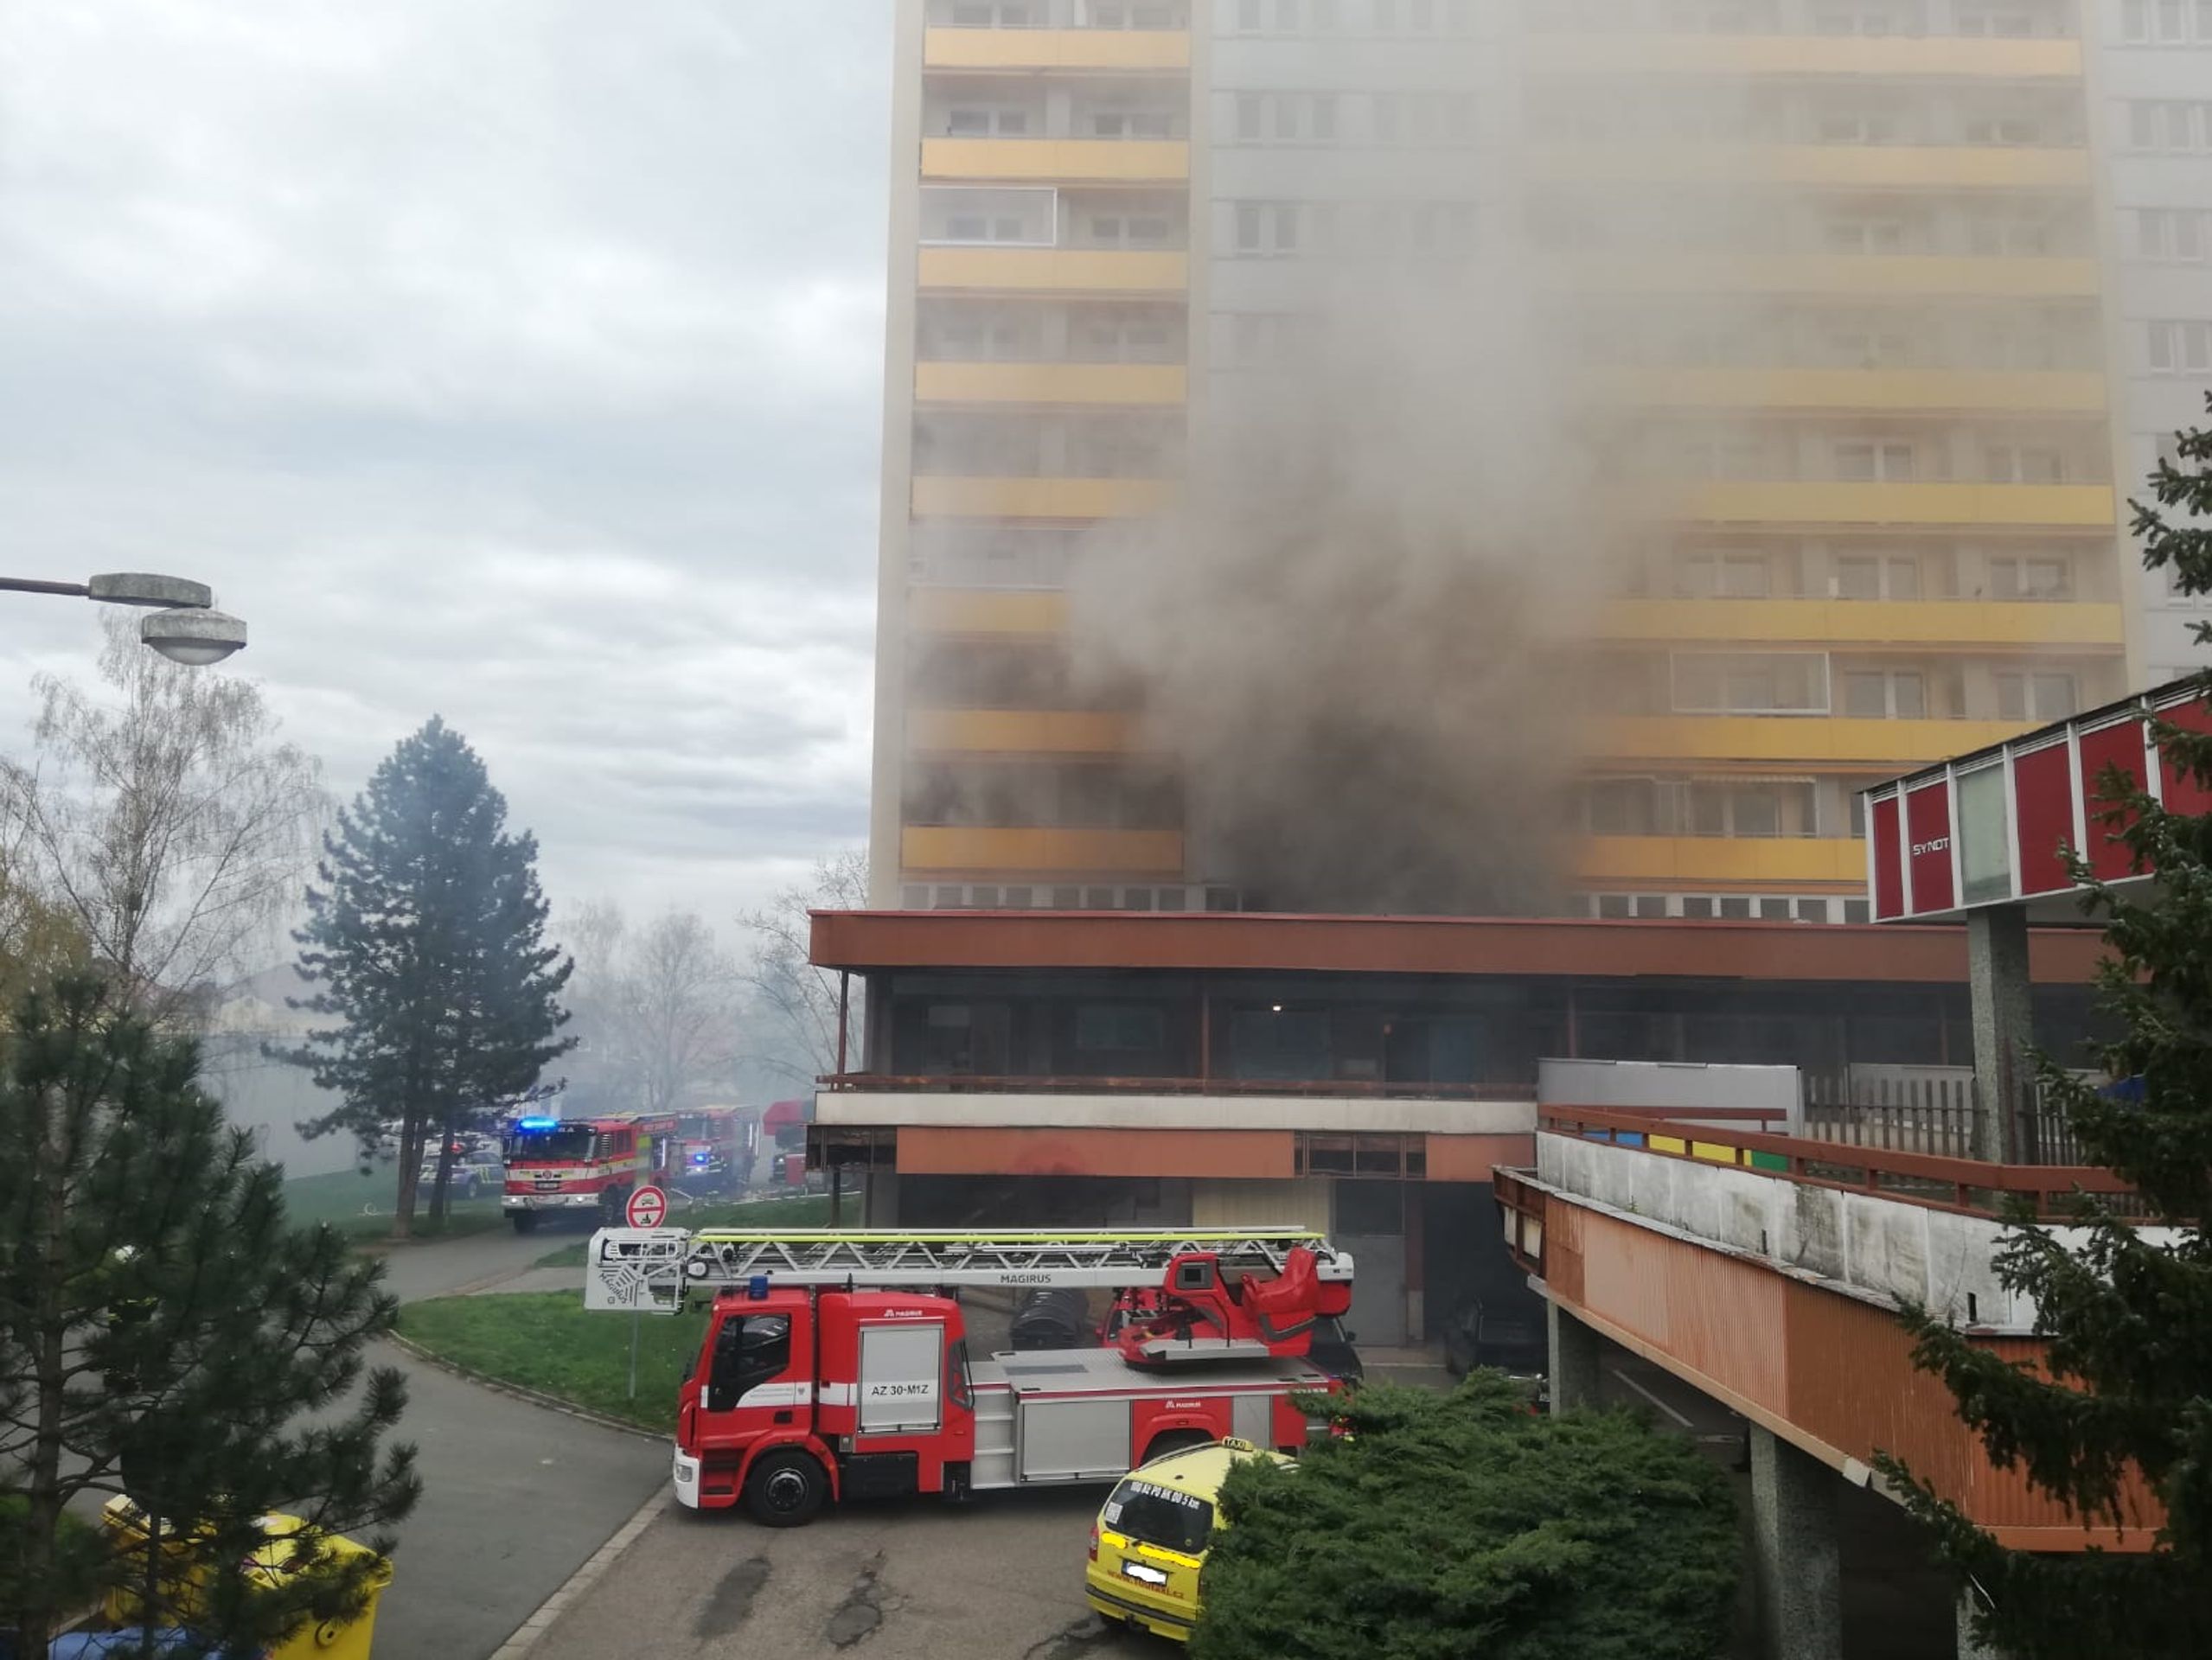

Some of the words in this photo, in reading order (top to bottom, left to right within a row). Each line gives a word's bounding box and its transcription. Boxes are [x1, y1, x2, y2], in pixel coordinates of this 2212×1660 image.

[1913, 838, 1949, 855] SYNOT
[1001, 1274, 1052, 1284] MAGIRUS
[872, 1386, 888, 1395] AZ
[890, 1384, 929, 1395] 30-M1Z
[1181, 1495, 1190, 1506] 5
